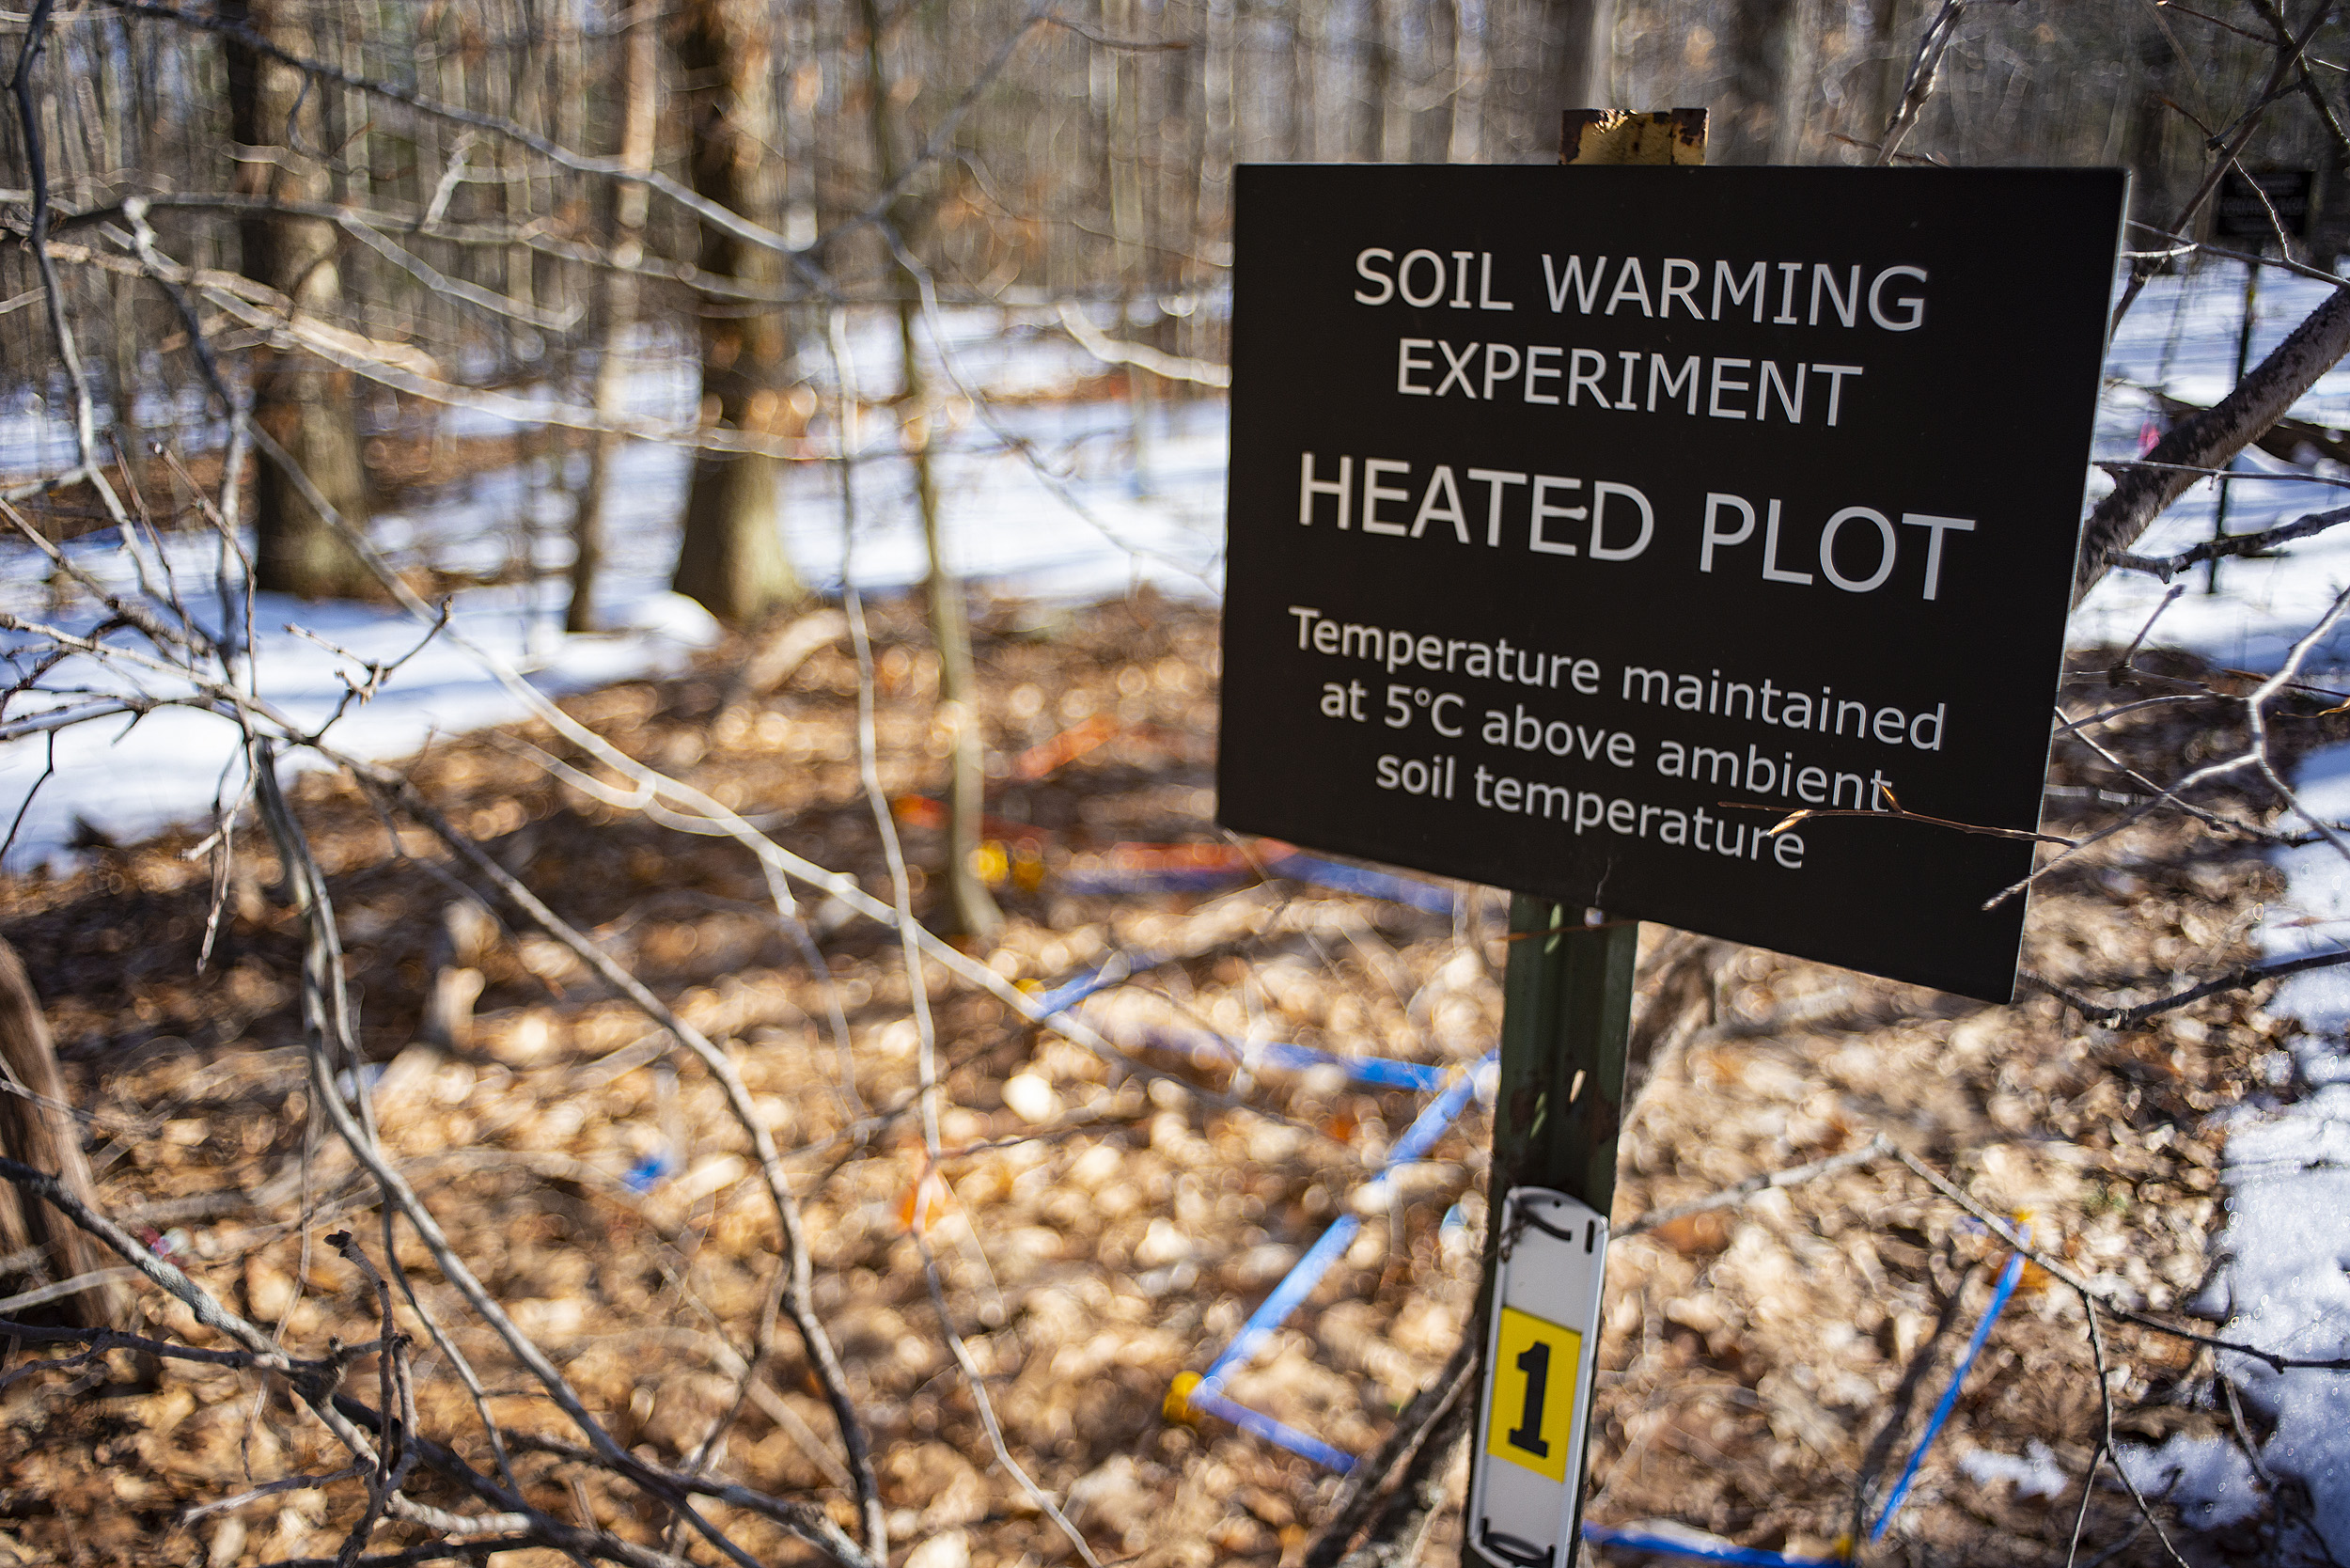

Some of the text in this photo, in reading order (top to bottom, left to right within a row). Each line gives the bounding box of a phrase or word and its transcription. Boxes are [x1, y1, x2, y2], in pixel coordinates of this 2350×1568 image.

[1355, 248, 1927, 332] SOIL WARMING
[1397, 338, 1863, 427] EXPERIMENT
[1299, 453, 1976, 601] HEATED PLOT
[1289, 607, 1946, 751] Temperature maintained
[1321, 681, 1893, 813] at 5°C above ambient
[1376, 752, 1805, 870] soil temperature
[1509, 1341, 1551, 1458] 1
